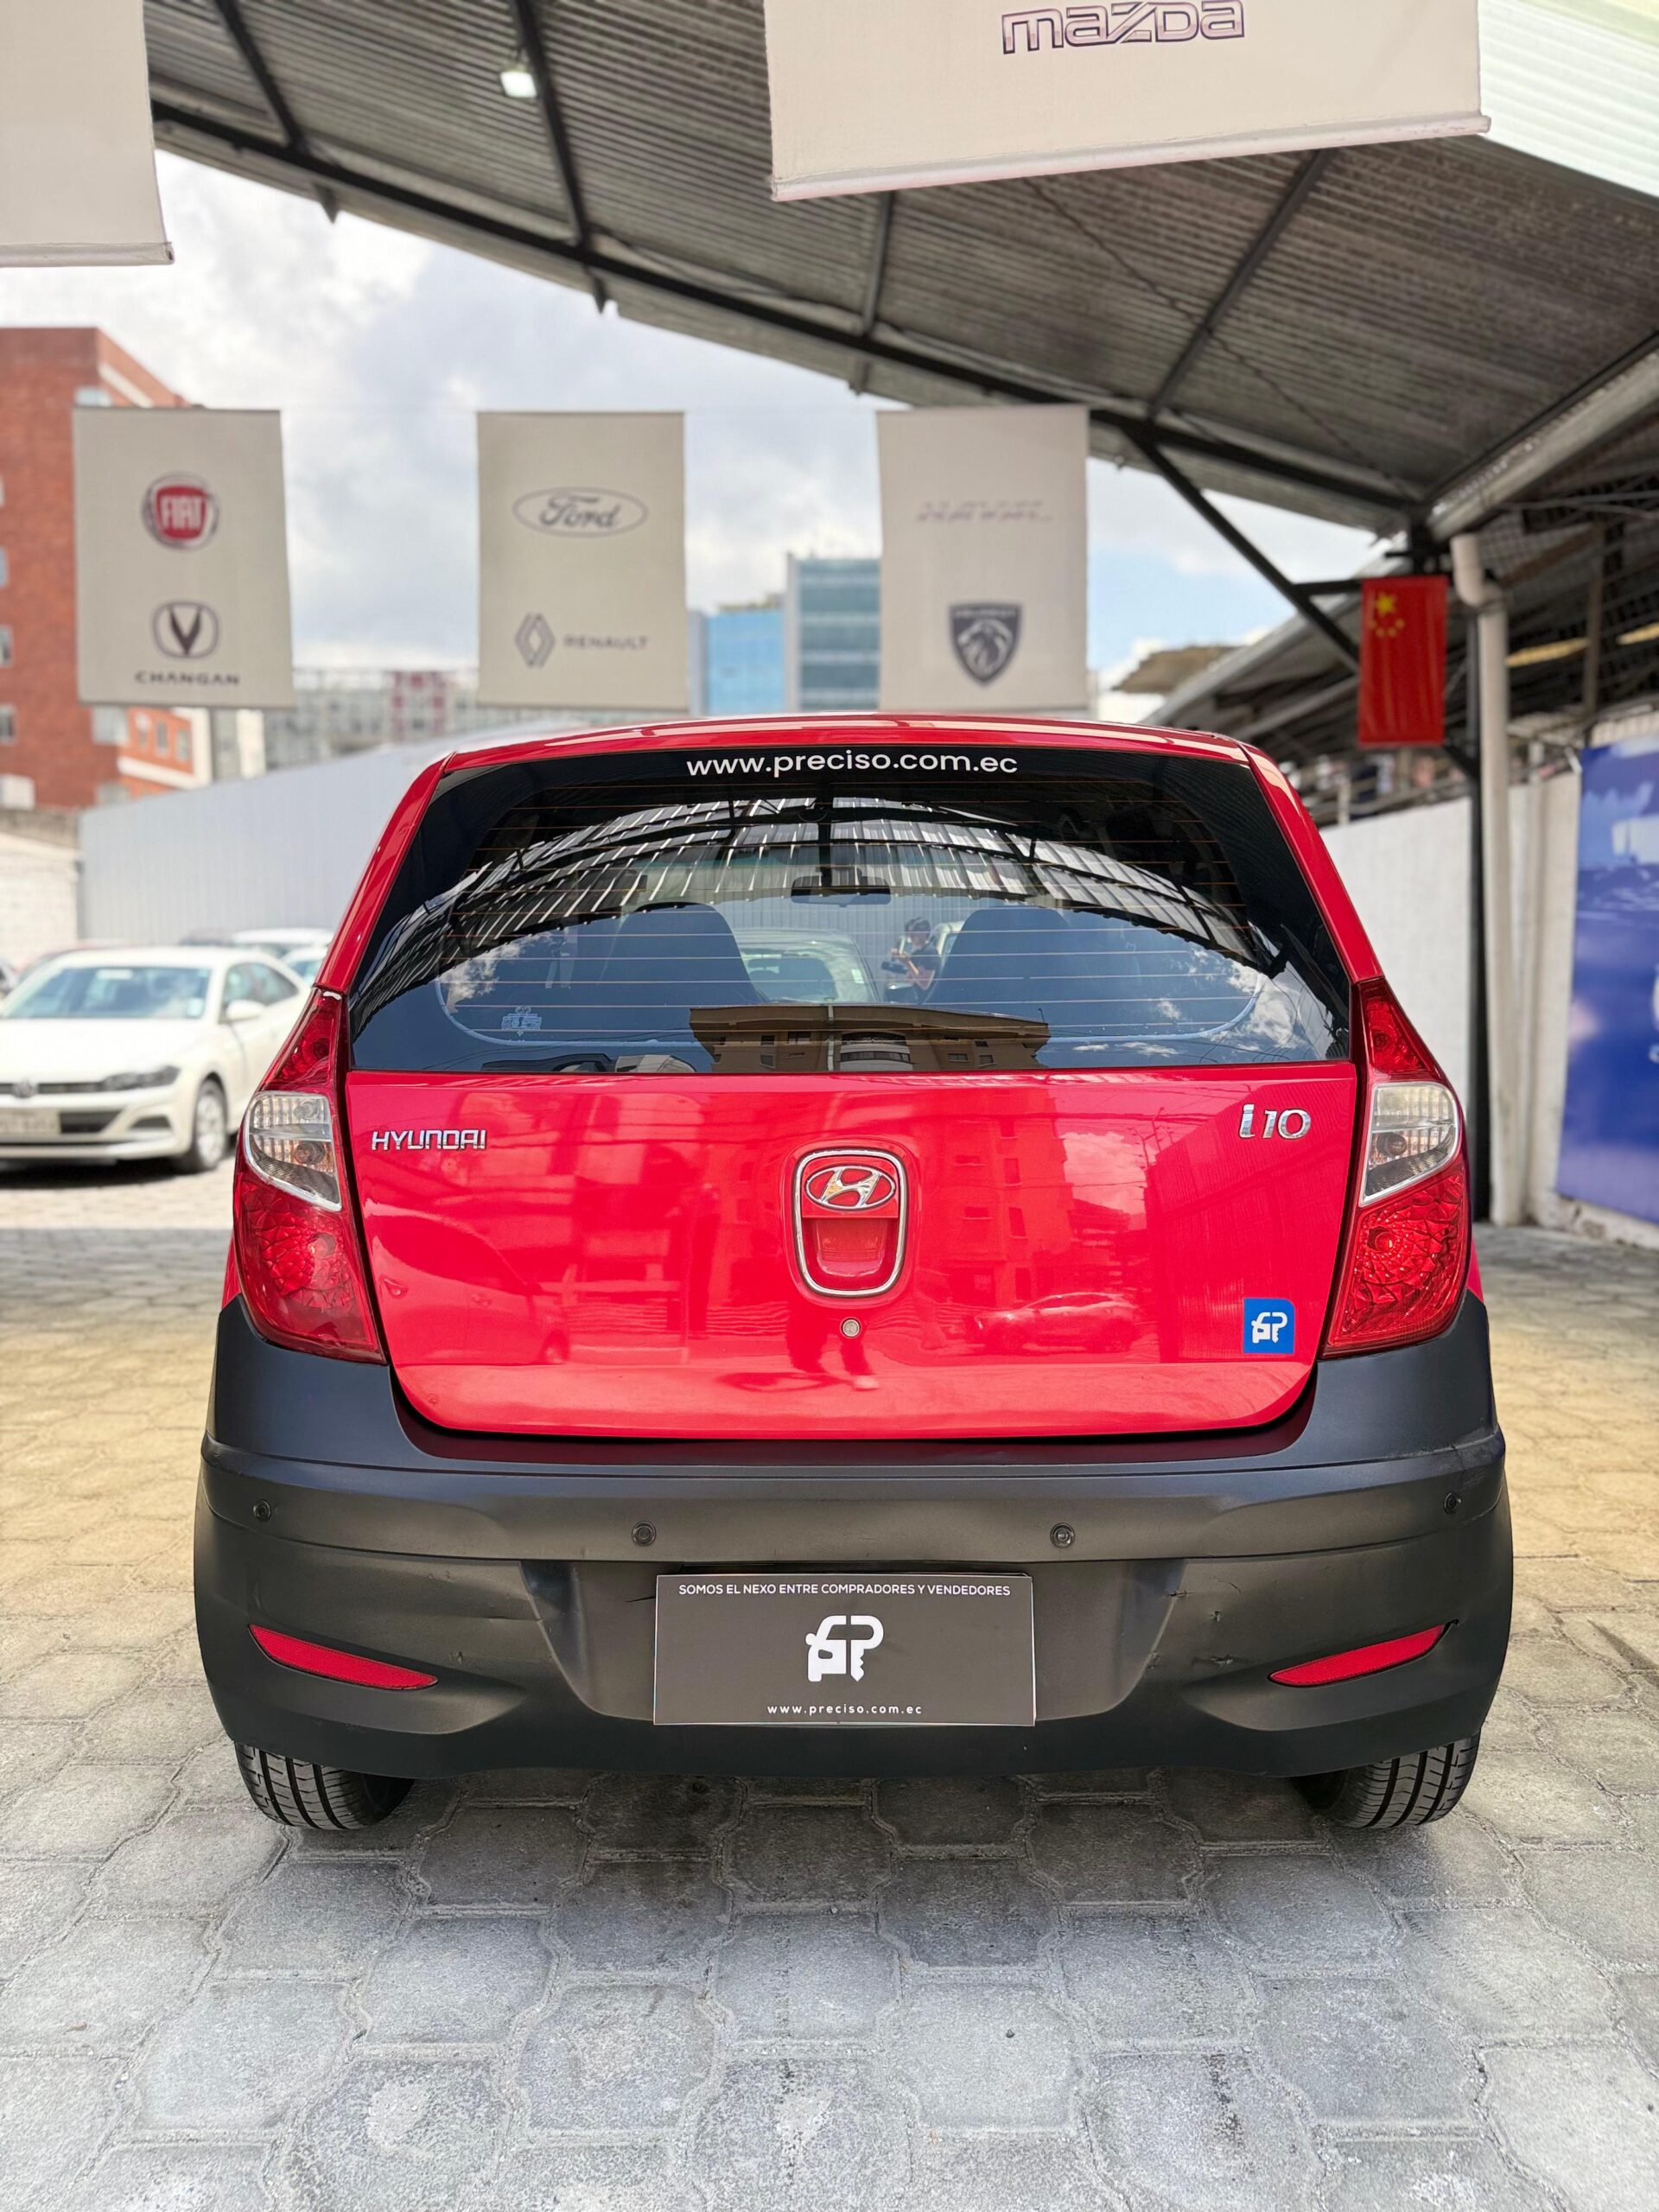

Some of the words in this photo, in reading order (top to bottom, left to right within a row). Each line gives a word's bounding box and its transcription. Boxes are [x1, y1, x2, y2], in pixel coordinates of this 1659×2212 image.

[161, 495, 203, 531] FIAT
[540, 494, 620, 528] Ford
[135, 671, 239, 685] CHANGAN
[686, 750, 1018, 778] www.preciso.com.ec
[371, 1129, 486, 1151] HYUNDAI
[678, 1584, 723, 1595] SOMOS
[726, 1584, 741, 1594] EL
[743, 1584, 776, 1594] NEXO
[779, 1584, 818, 1594] ENTRE
[821, 1584, 915, 1594] COMPRADORES
[918, 1585, 925, 1594] Y
[927, 1585, 1011, 1595] VENDEDORES
[767, 1704, 922, 1715] www.preciso.com.ec
